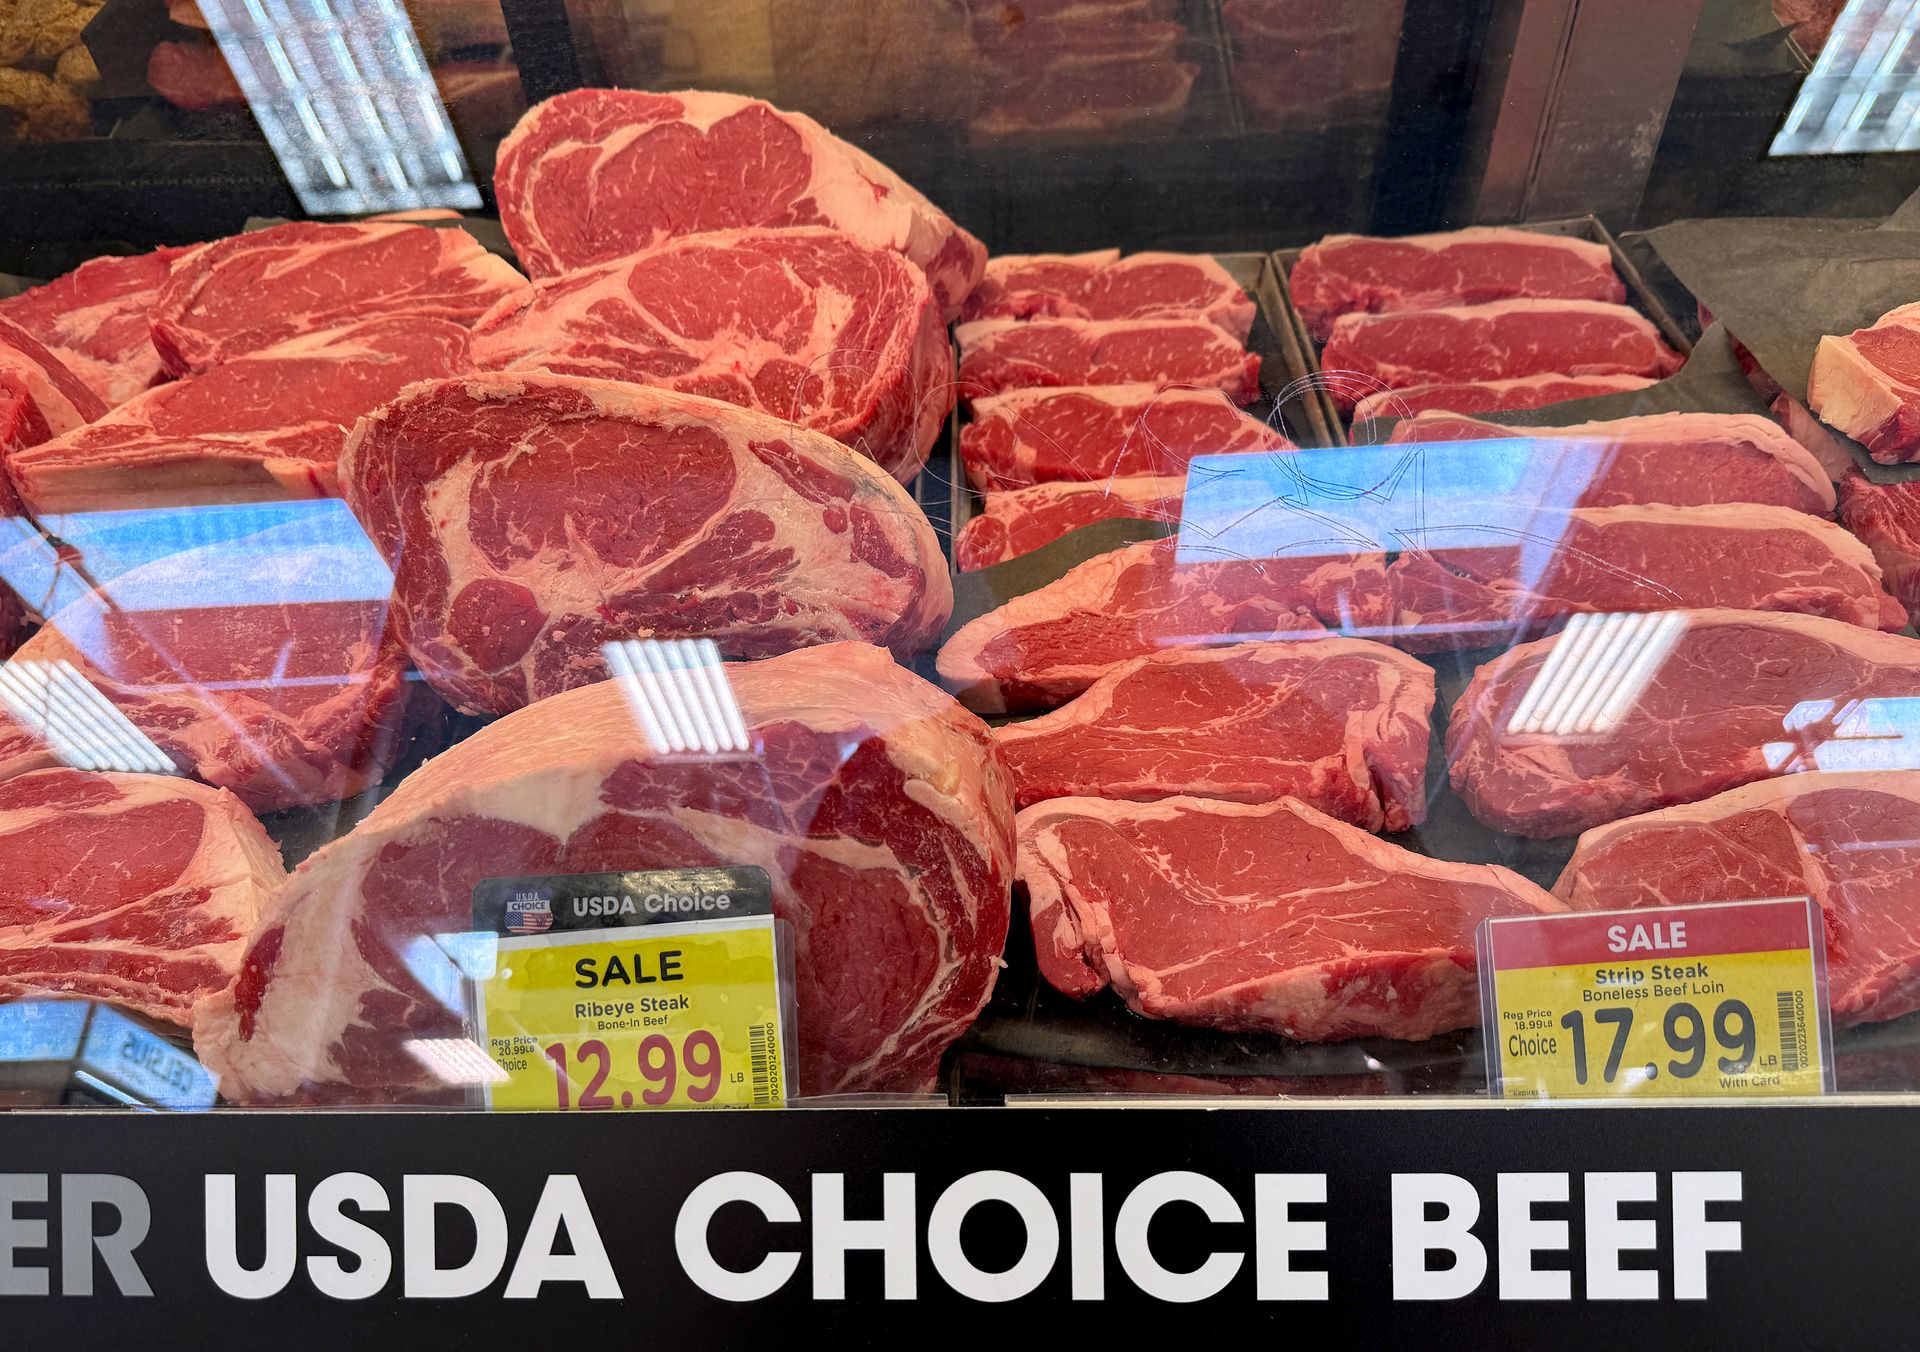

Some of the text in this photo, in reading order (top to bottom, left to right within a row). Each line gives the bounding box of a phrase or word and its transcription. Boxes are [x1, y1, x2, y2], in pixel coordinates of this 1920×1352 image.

[511, 901, 546, 911] CHOICE
[573, 891, 731, 917] USDA Choice
[1607, 920, 1689, 953] SALE
[574, 949, 686, 990] SALE
[1594, 961, 1710, 987] Strip Steak
[1581, 980, 1725, 1003] Boneless Beef Loin
[574, 993, 690, 1020] Ribeye Steak
[1503, 1008, 1552, 1021] Reg Price
[597, 1014, 669, 1032] Bone-In Beef
[491, 1035, 538, 1048] Reg Price
[1508, 1032, 1557, 1057] Choice
[1560, 998, 1757, 1086] 17.99
[544, 1029, 723, 1111] 12.99
[1759, 1054, 1778, 1067] LB
[730, 1072, 745, 1084] LB
[1718, 1074, 1781, 1089] With Card
[0, 1170, 1743, 1304] ER USDA CHOICE BEEF
